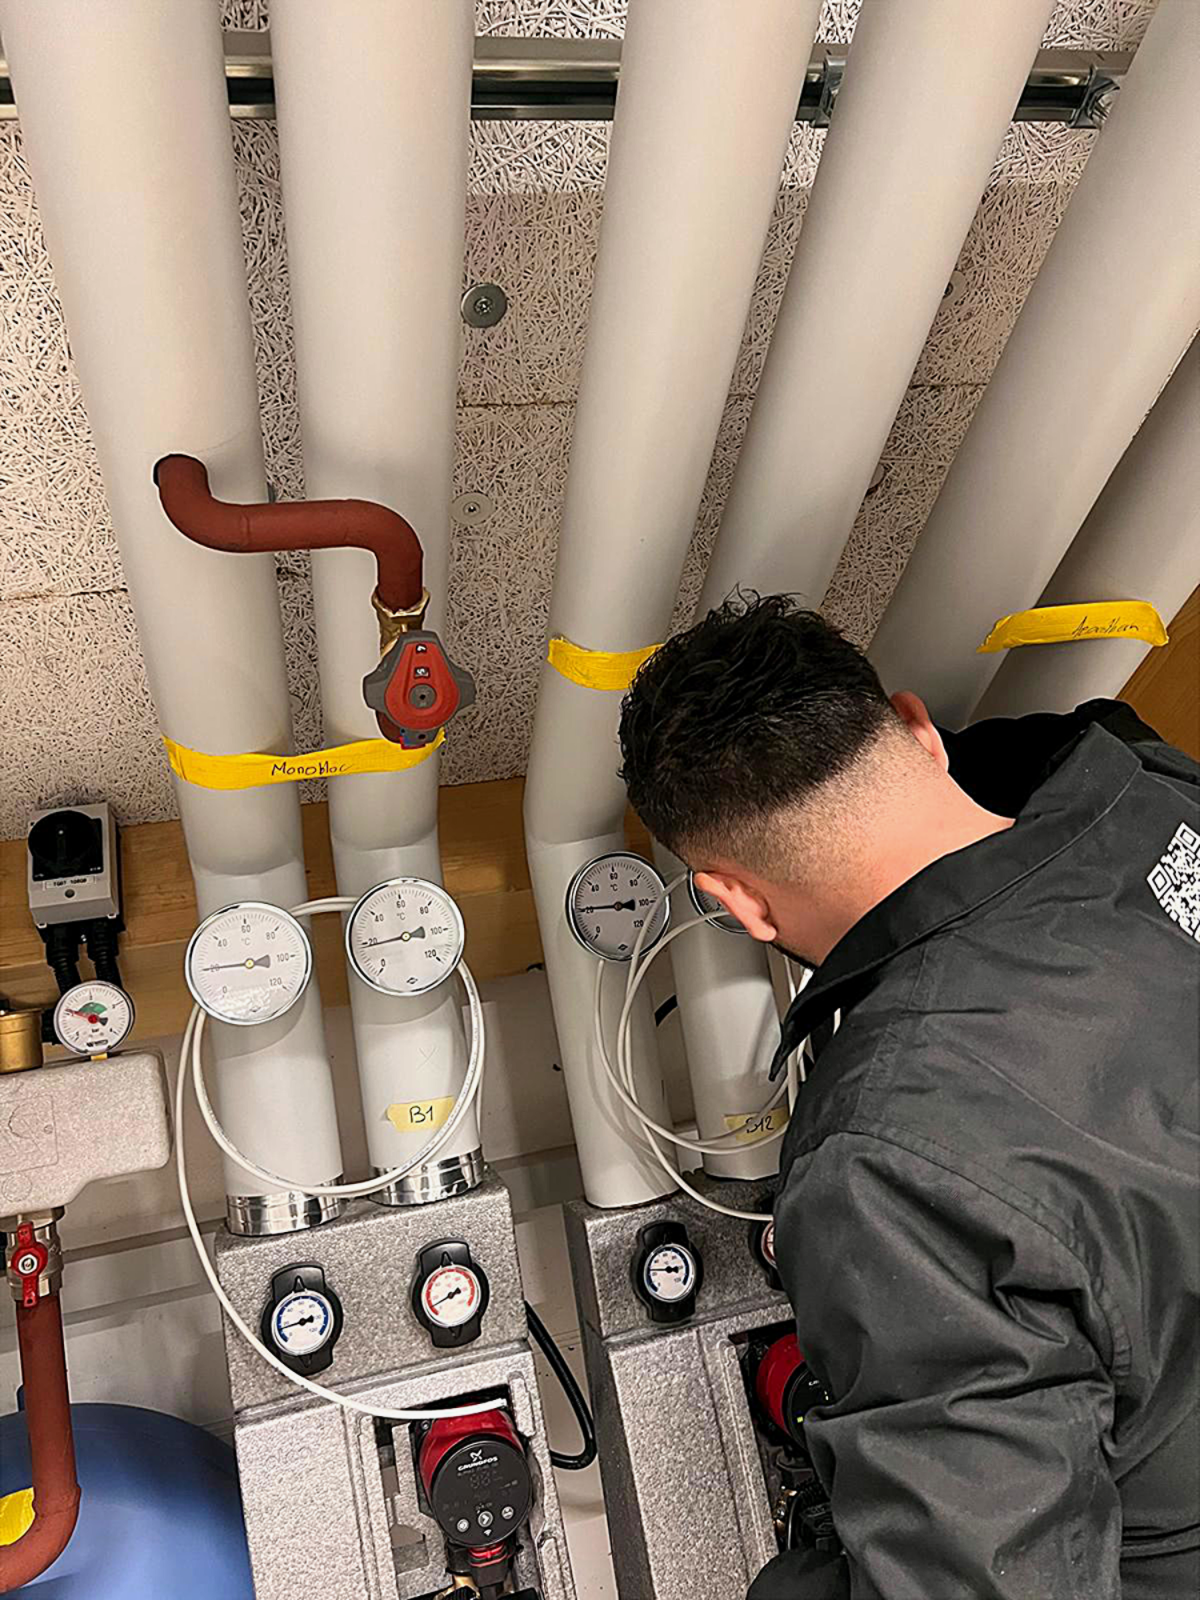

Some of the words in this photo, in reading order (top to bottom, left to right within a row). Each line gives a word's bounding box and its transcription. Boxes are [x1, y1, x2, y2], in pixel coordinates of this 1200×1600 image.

[271, 760, 353, 776] Monobloc
[396, 899, 406, 908] 60
[638, 898, 649, 907] 100
[420, 906, 429, 915] 80
[374, 913, 384, 922] 40
[633, 919, 644, 928] 120
[241, 925, 251, 933] 60
[430, 926, 442, 935] 100
[595, 926, 601, 934] 0
[266, 931, 275, 940] 80
[217, 938, 227, 948] 40
[368, 937, 378, 945] 20
[277, 952, 289, 962] 100
[424, 949, 437, 958] 120
[380, 958, 386, 967] 0
[269, 977, 282, 986] 120
[222, 986, 227, 994] 0
[409, 1105, 433, 1123] B1
